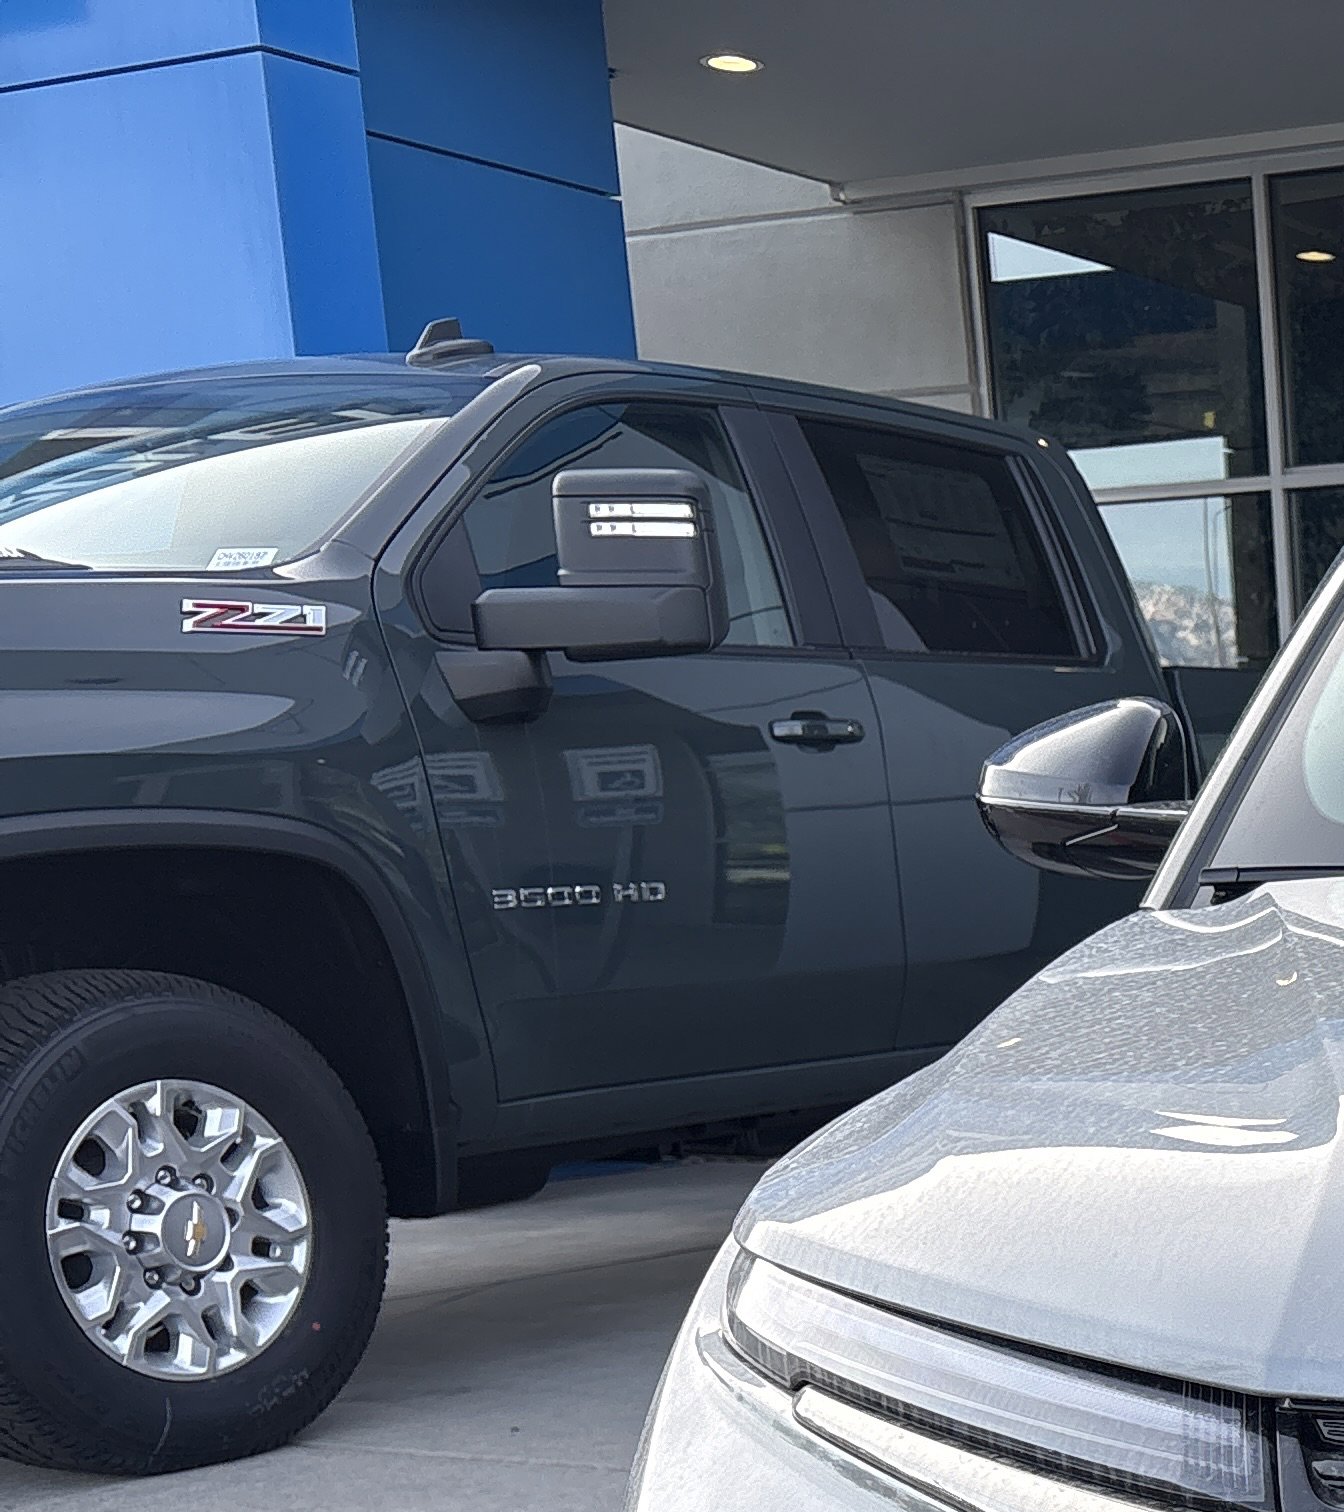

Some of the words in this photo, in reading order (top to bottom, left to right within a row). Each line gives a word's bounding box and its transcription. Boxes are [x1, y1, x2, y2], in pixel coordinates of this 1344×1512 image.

[181, 599, 326, 635] Z71
[492, 885, 600, 909] 3500
[613, 882, 666, 902] HD
